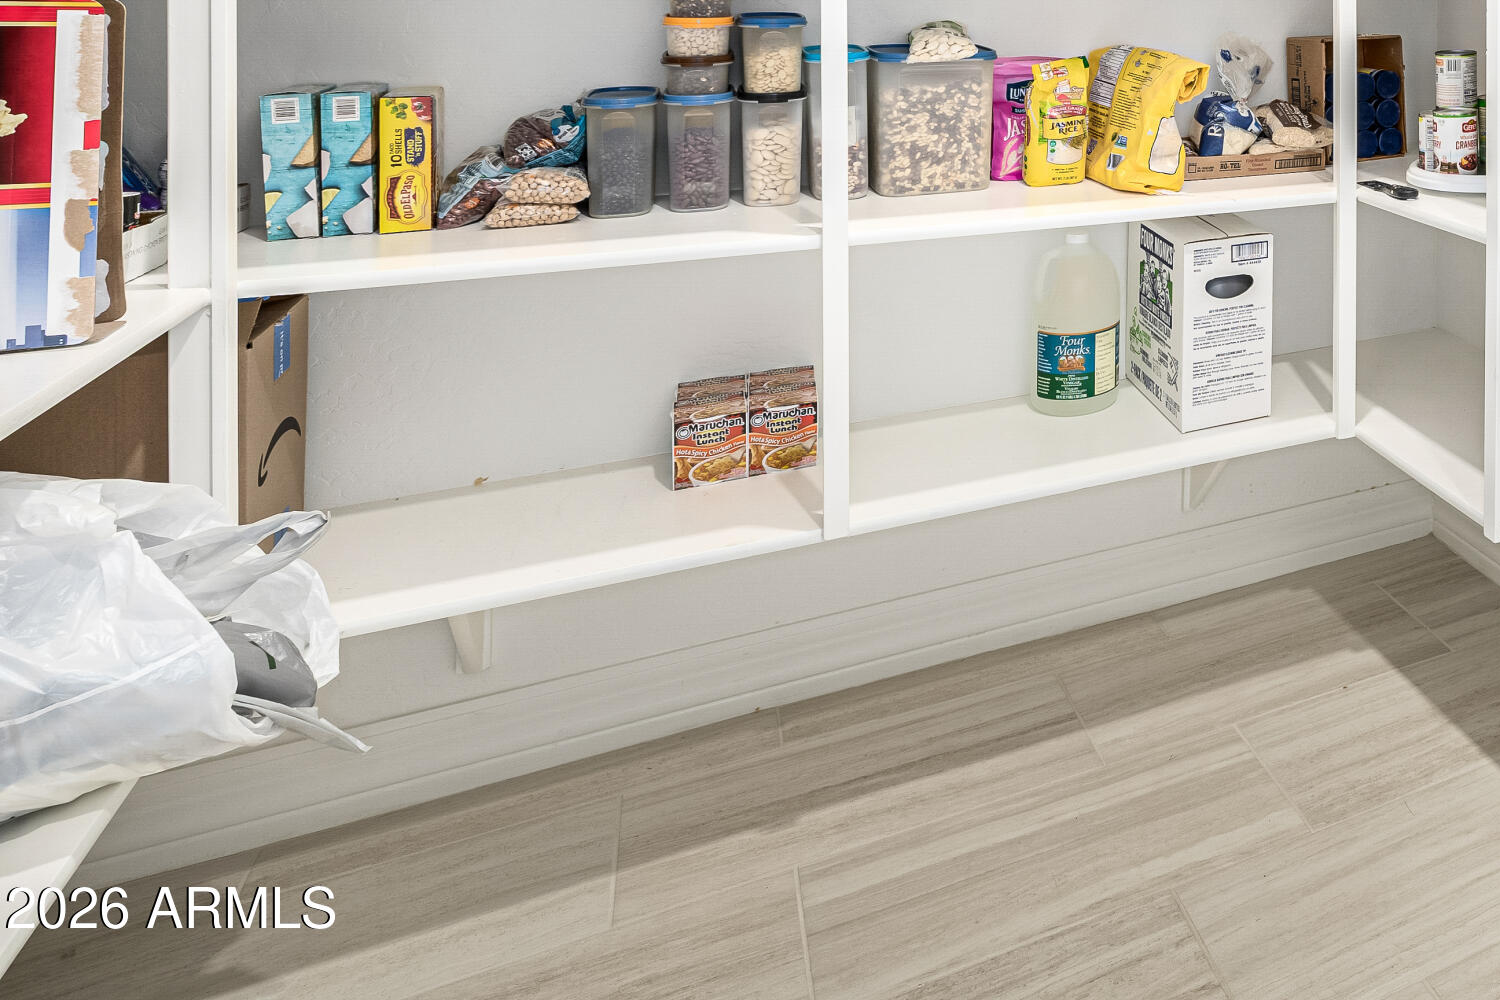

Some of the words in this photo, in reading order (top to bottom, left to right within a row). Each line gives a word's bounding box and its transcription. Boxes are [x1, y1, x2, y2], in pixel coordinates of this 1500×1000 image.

[1058, 125, 1078, 135] RICE
[394, 128, 402, 154] SHELLS
[415, 130, 423, 152] STUFF
[406, 139, 415, 163] STAND
[390, 154, 402, 168] 10
[1140, 227, 1154, 253] FOUR
[1154, 236, 1173, 266] MONKS
[1059, 335, 1086, 346] Four
[1053, 345, 1091, 357] Monks
[762, 406, 816, 421] Maruchan
[688, 416, 745, 433] Maruchan
[766, 418, 802, 428] Instant
[692, 429, 730, 441] Instant
[770, 425, 798, 434] Lunch
[696, 436, 726, 446] Lunch
[781, 433, 805, 443] Chicken
[708, 444, 733, 455] Chicken
